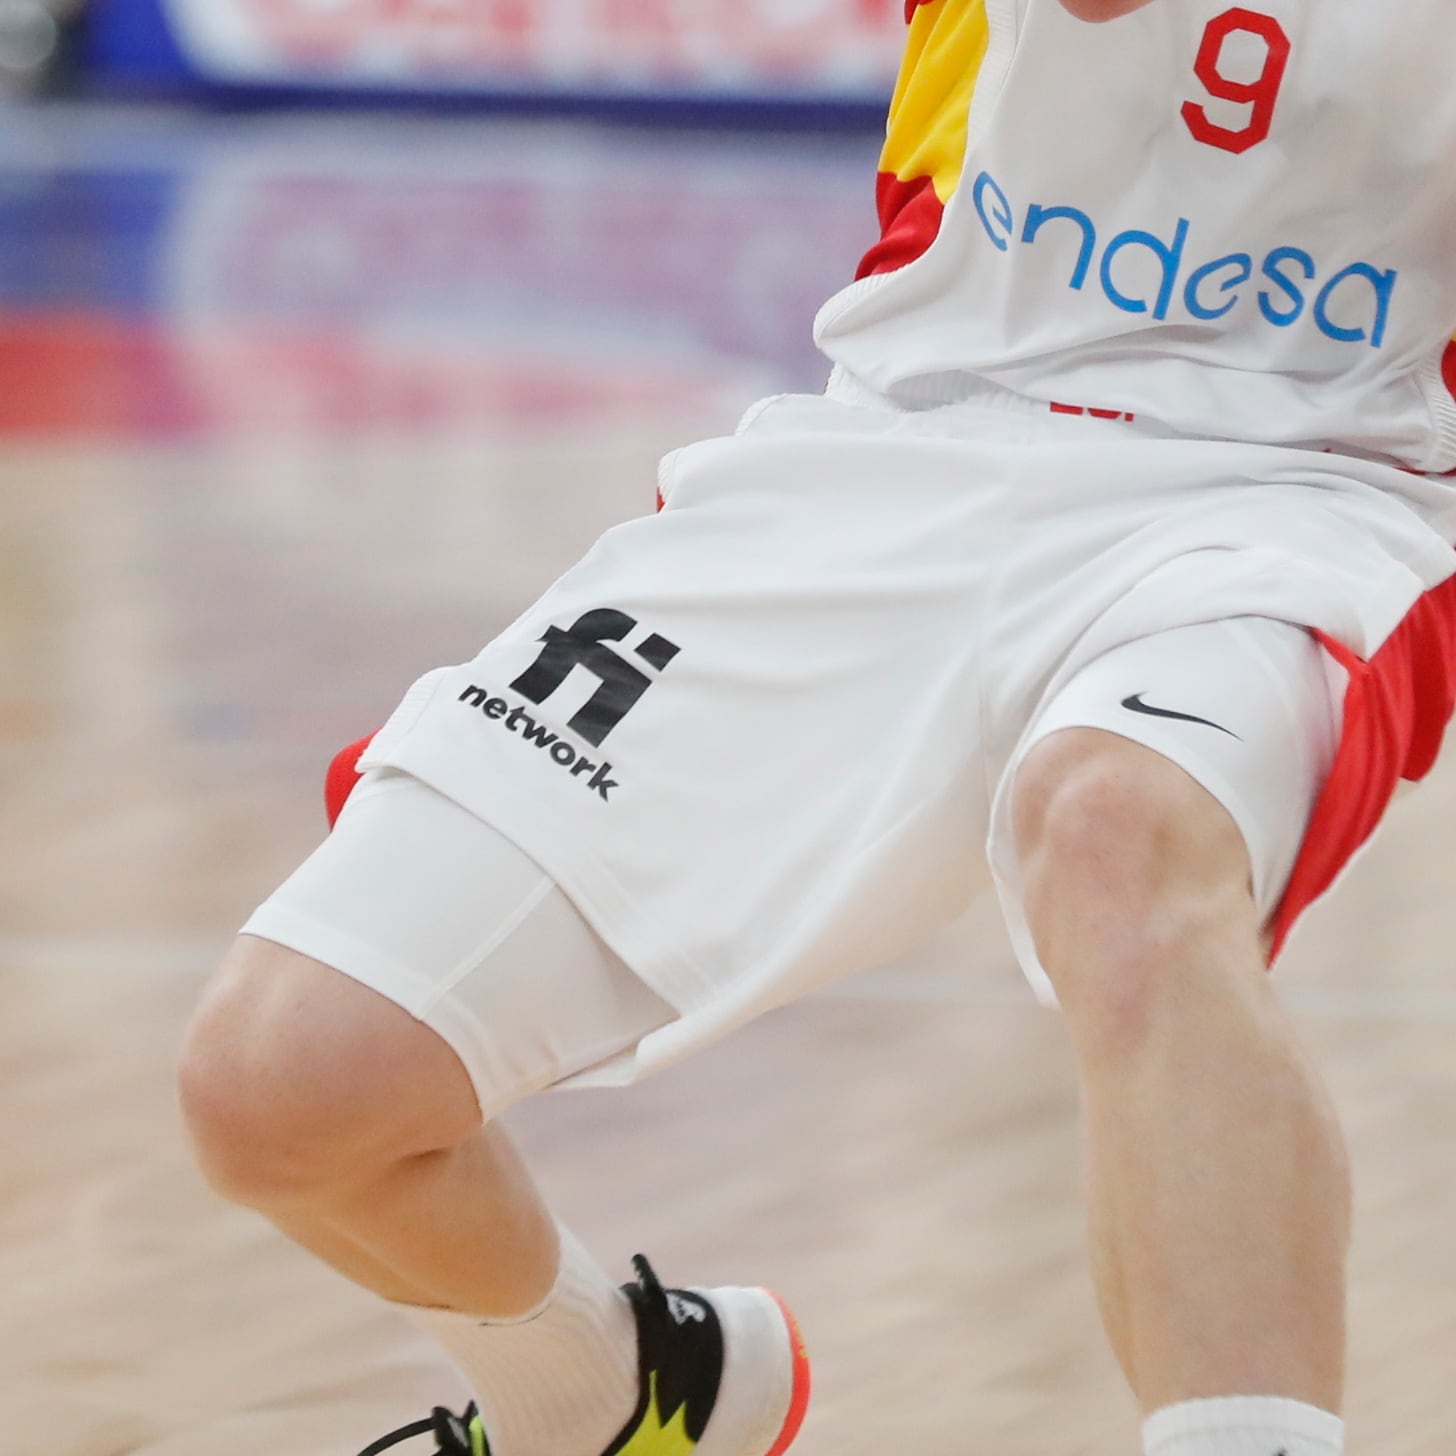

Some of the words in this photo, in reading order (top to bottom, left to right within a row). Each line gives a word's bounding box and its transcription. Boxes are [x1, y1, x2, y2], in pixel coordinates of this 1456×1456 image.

[1179, 6, 1292, 156] 9
[972, 170, 1398, 349] endesa
[457, 683, 620, 803] network
[507, 607, 682, 750] fi
